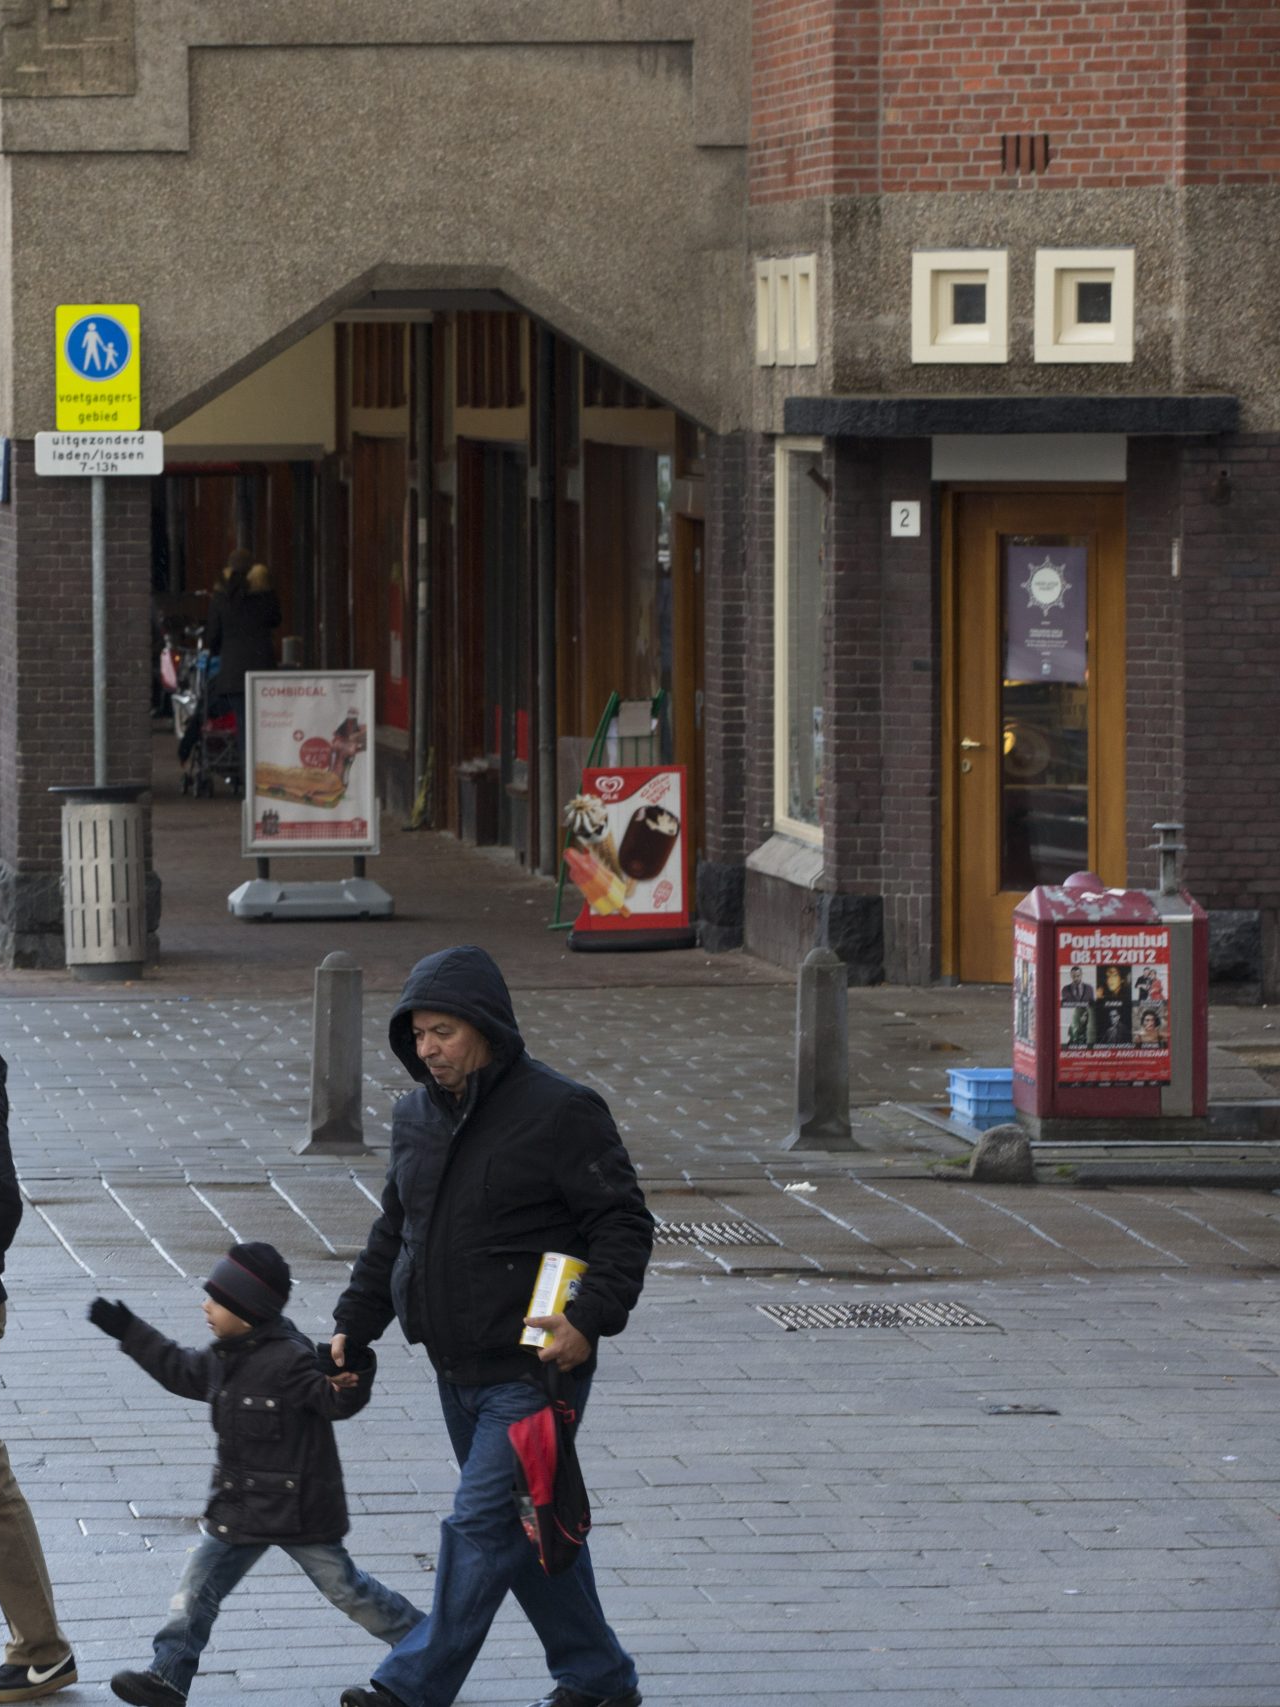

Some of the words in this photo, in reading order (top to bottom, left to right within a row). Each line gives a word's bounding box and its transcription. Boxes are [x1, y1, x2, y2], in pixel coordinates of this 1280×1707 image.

[59, 393, 137, 405] voetgangers-
[78, 411, 118, 424] gebied
[52, 435, 145, 447] uitgezonderd
[52, 449, 144, 461] laden/lossen
[80, 462, 118, 472] 7-13h
[900, 508, 910, 528] 2
[261, 687, 327, 697] COMBIDEAL
[1071, 949, 1157, 964] 08.12.2012
